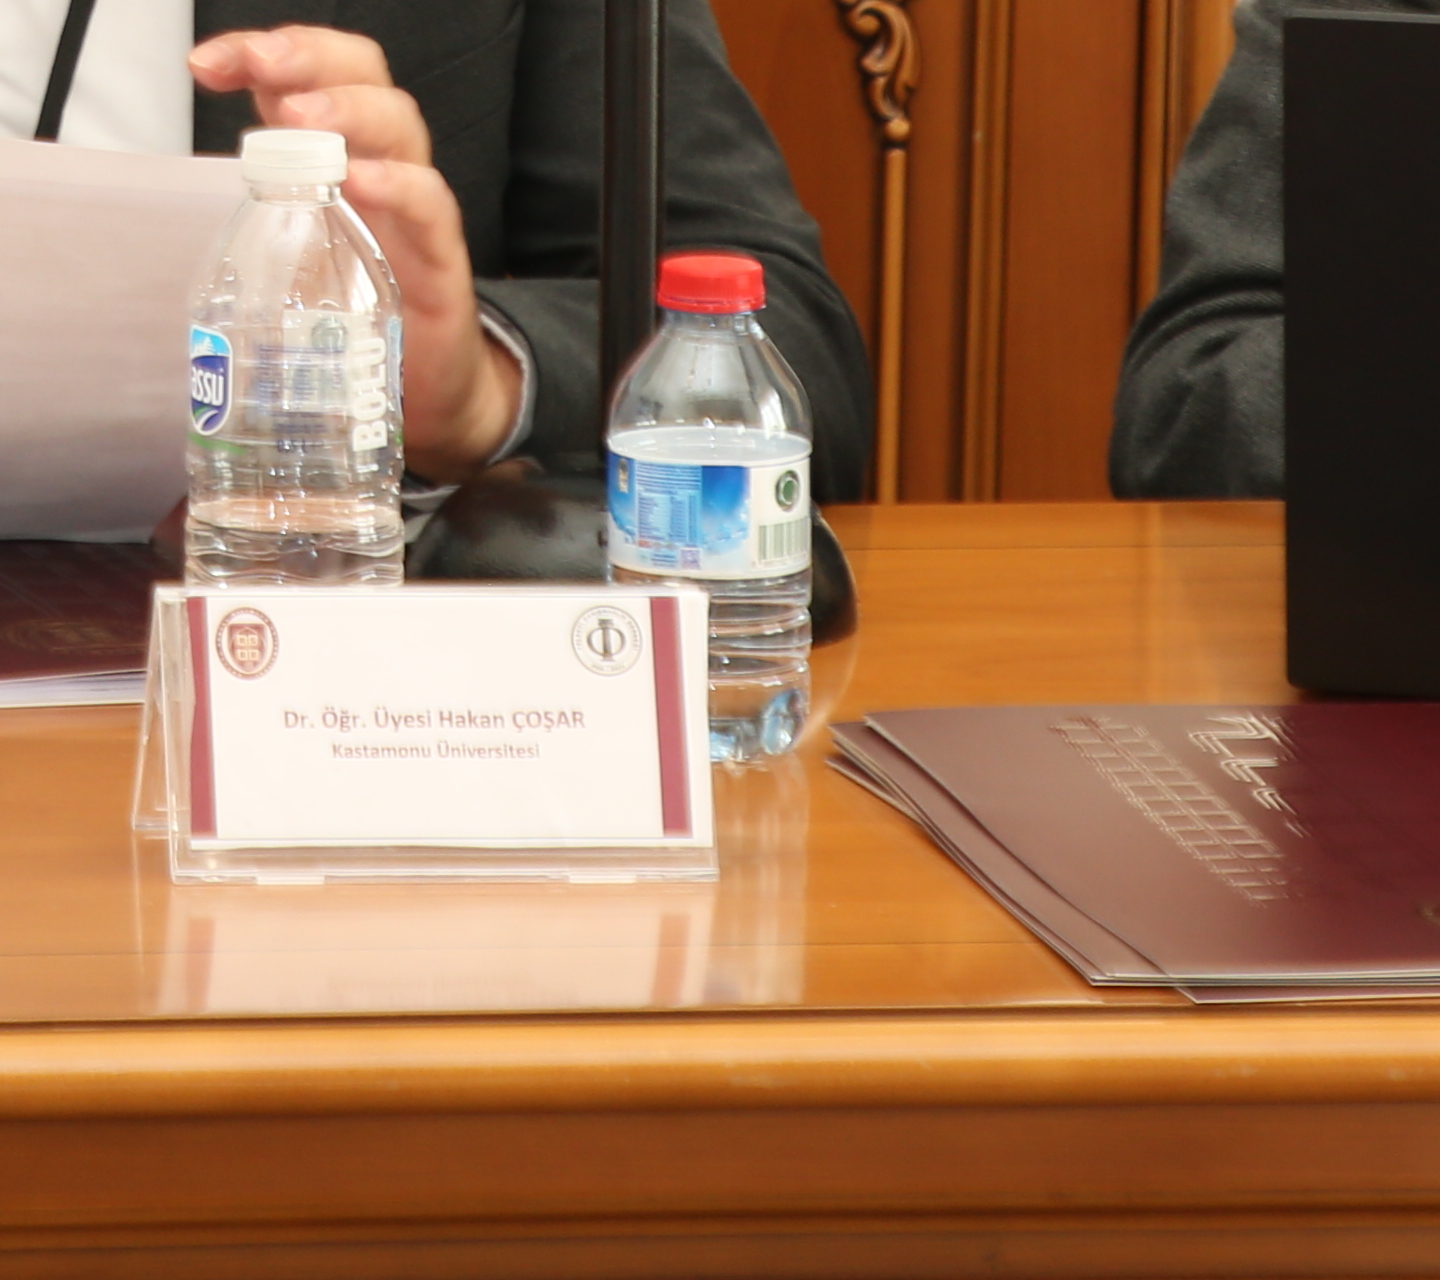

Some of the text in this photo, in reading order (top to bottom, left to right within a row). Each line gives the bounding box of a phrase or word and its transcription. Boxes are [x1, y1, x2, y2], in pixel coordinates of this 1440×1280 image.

[351, 336, 388, 453] BOLU
[283, 706, 587, 733] Dr. Öğr. Üyesi Hakan ÇOŞAR
[332, 739, 541, 760] Kastamonu Üniversitesi
